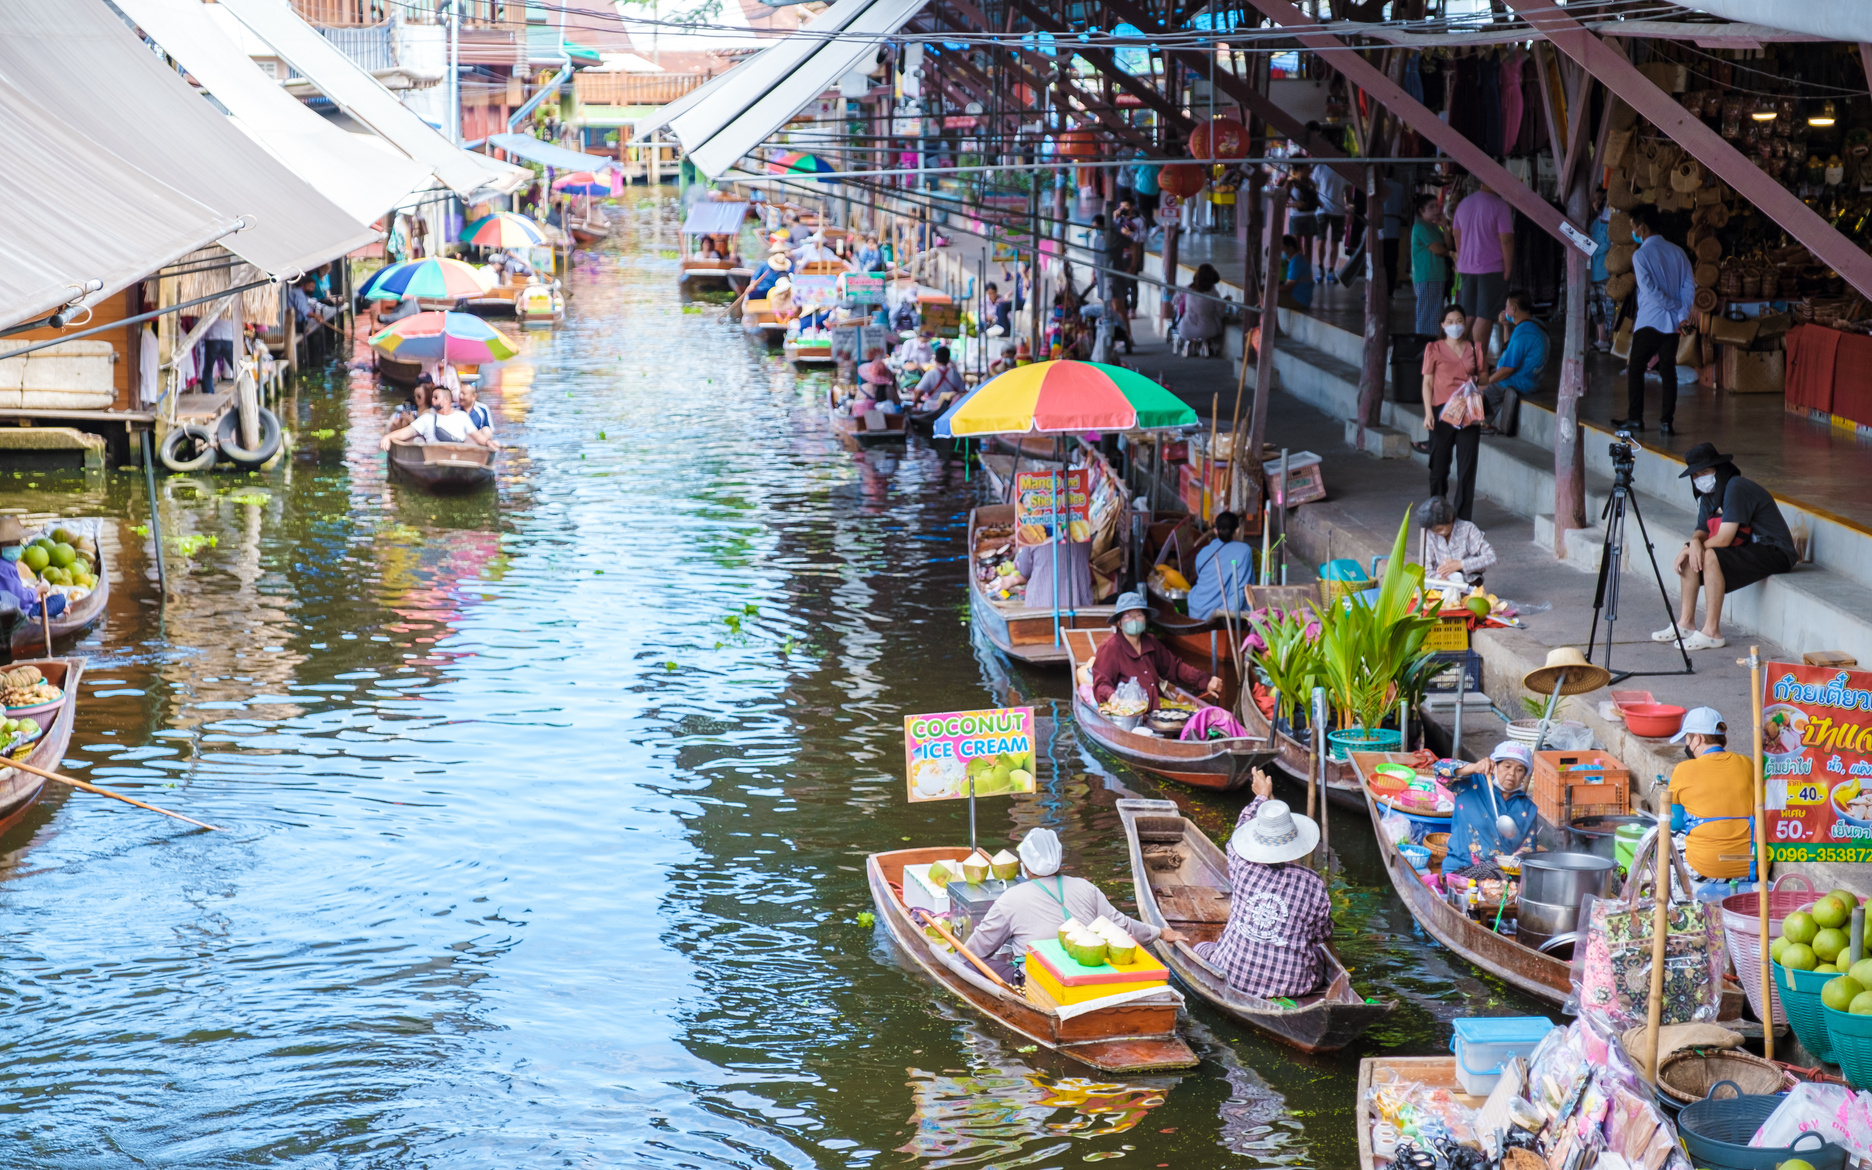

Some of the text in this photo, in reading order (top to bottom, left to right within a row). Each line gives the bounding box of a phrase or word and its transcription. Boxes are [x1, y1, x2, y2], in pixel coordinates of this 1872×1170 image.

[1020, 475, 1061, 492] Mango
[1031, 494, 1060, 509] Sticy
[1774, 671, 1872, 711] ก๋วยเตี๋ยว
[912, 713, 1026, 738] COCONUT
[922, 736, 1029, 759] ICE CREAM
[1765, 756, 1813, 775] ต้มยำไข่
[1799, 787, 1823, 800] 40.-
[1781, 809, 1806, 818] พเศษ
[1776, 820, 1813, 839] 50.-
[1831, 819, 1872, 838] เย็นตา
